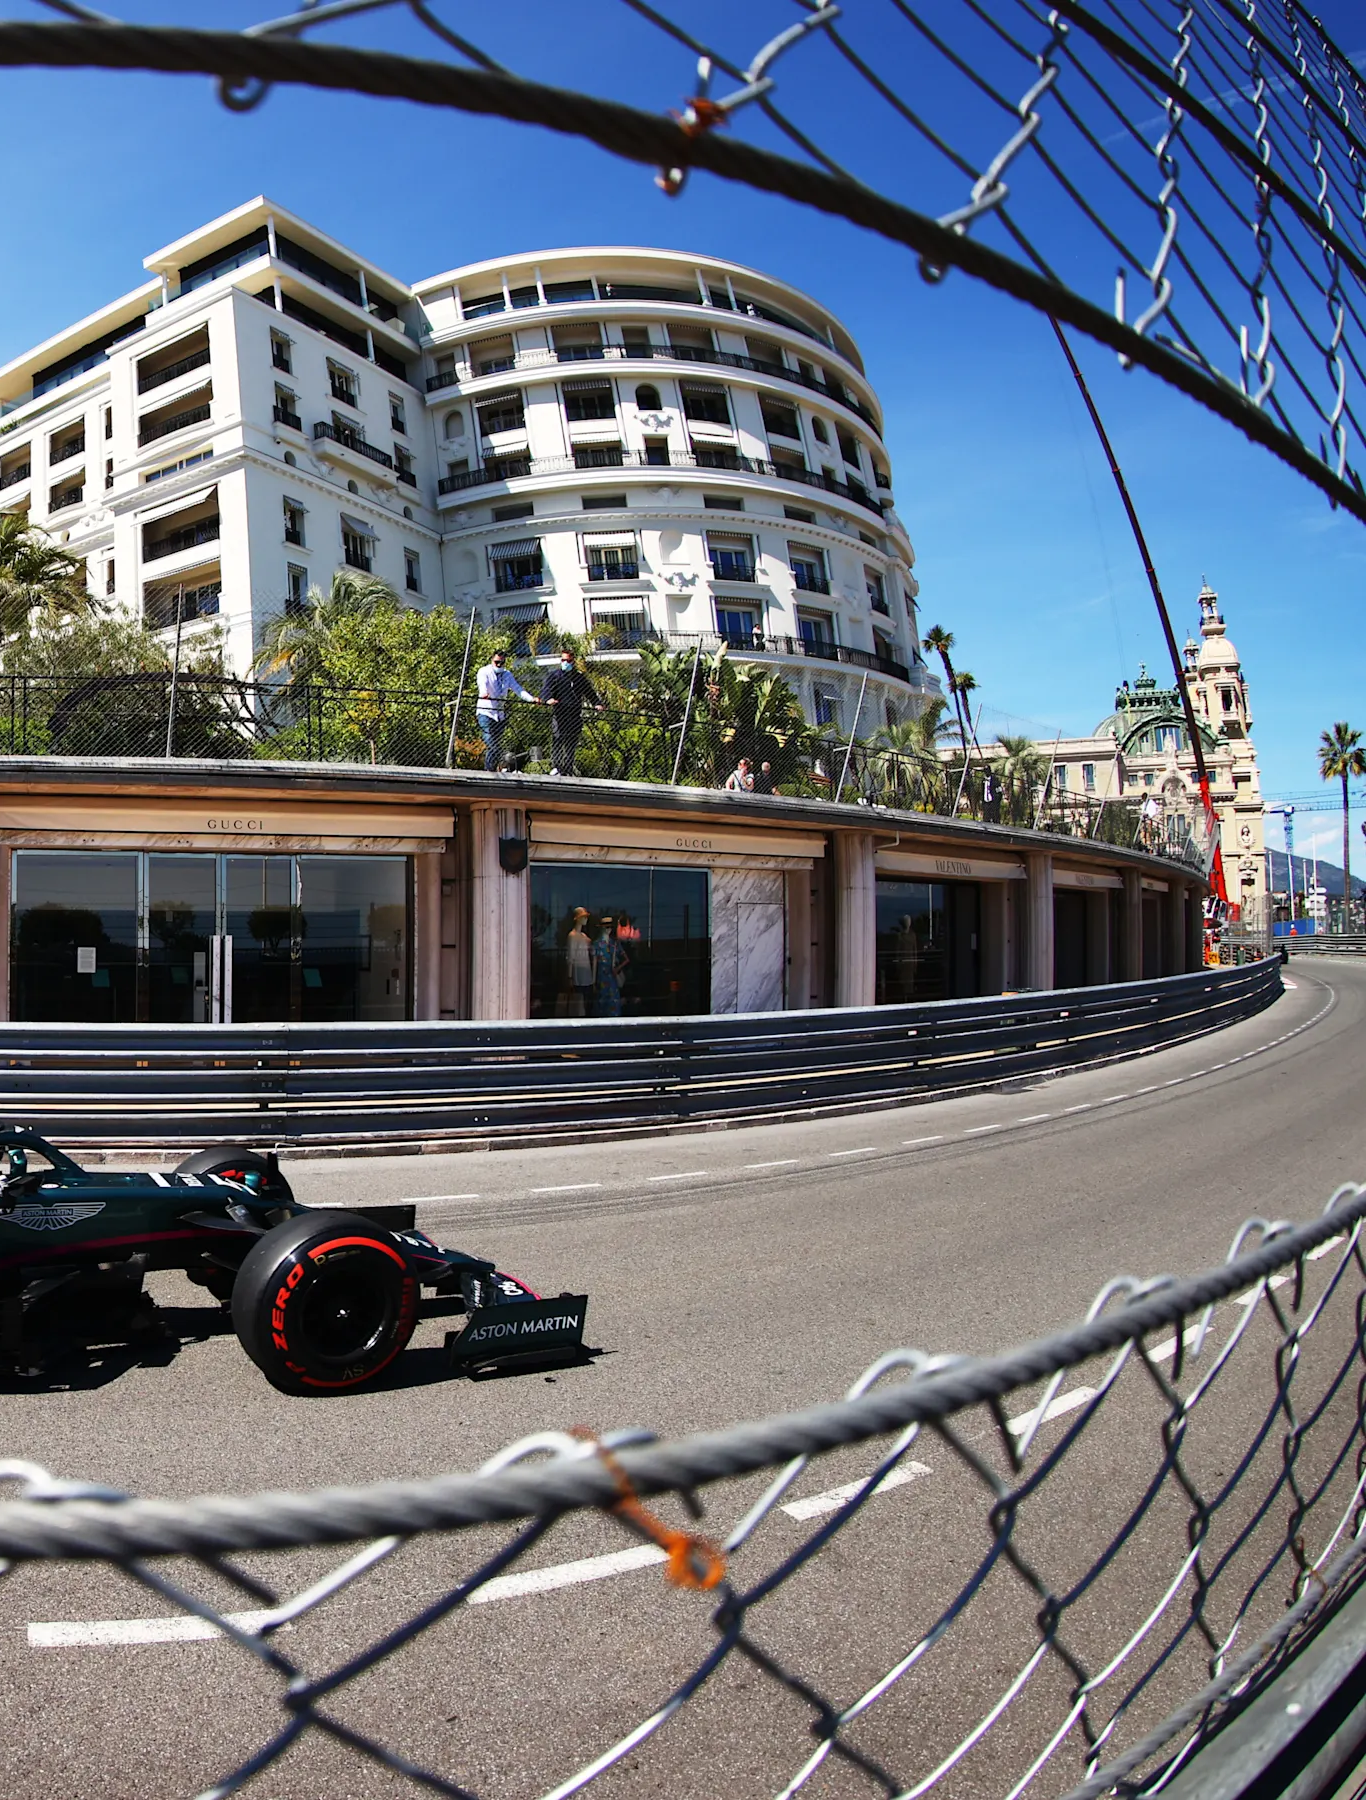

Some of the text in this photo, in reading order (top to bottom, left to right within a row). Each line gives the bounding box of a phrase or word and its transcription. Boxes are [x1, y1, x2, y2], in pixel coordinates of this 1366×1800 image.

[207, 819, 263, 830] GUCCI
[676, 838, 712, 849] GUCCI
[935, 859, 972, 875] VALENTINO
[22, 1208, 73, 1217] ASTON MARTIN
[271, 1263, 305, 1351] ZERO
[468, 1314, 579, 1342] ASTON MARTIN
